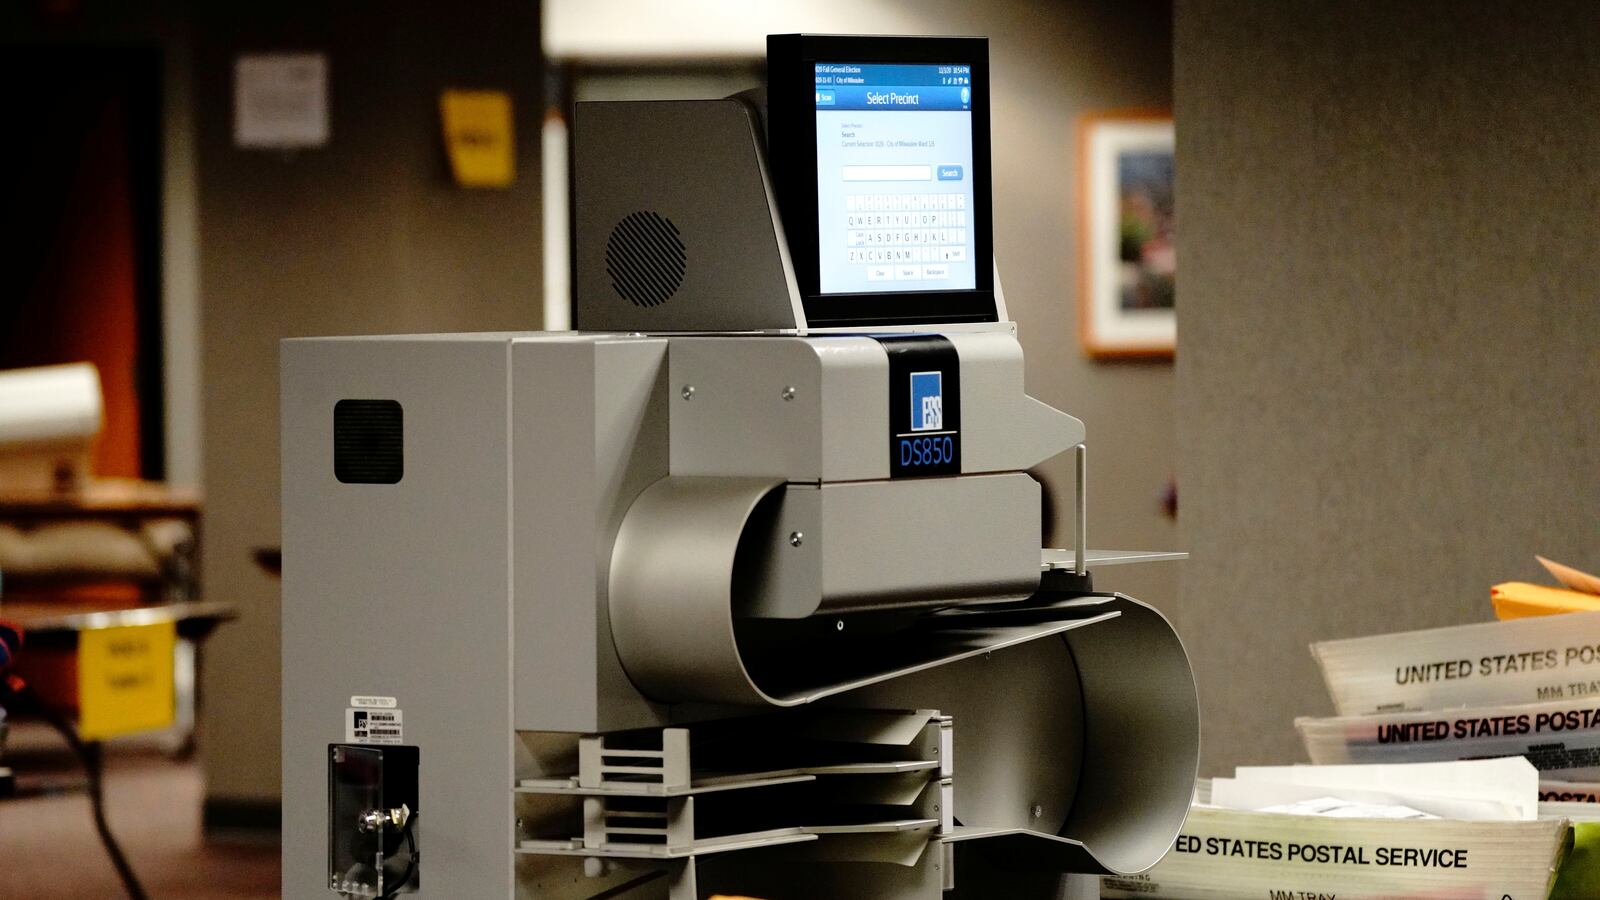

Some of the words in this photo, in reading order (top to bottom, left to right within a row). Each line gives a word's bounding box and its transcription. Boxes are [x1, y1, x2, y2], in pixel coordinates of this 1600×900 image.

[866, 91, 889, 105] Select
[890, 92, 919, 105] Precinct
[942, 169, 958, 177] Search
[901, 436, 953, 466] DS850
[1395, 659, 1472, 685] UNITED
[1479, 649, 1558, 677] STATES
[1536, 685, 1563, 700] MM
[1377, 721, 1450, 744] UNITED
[1454, 715, 1531, 739] STATES
[1206, 837, 1282, 860] STATES
[1288, 843, 1370, 865] POSTAL
[1375, 847, 1468, 868] SERVICE
